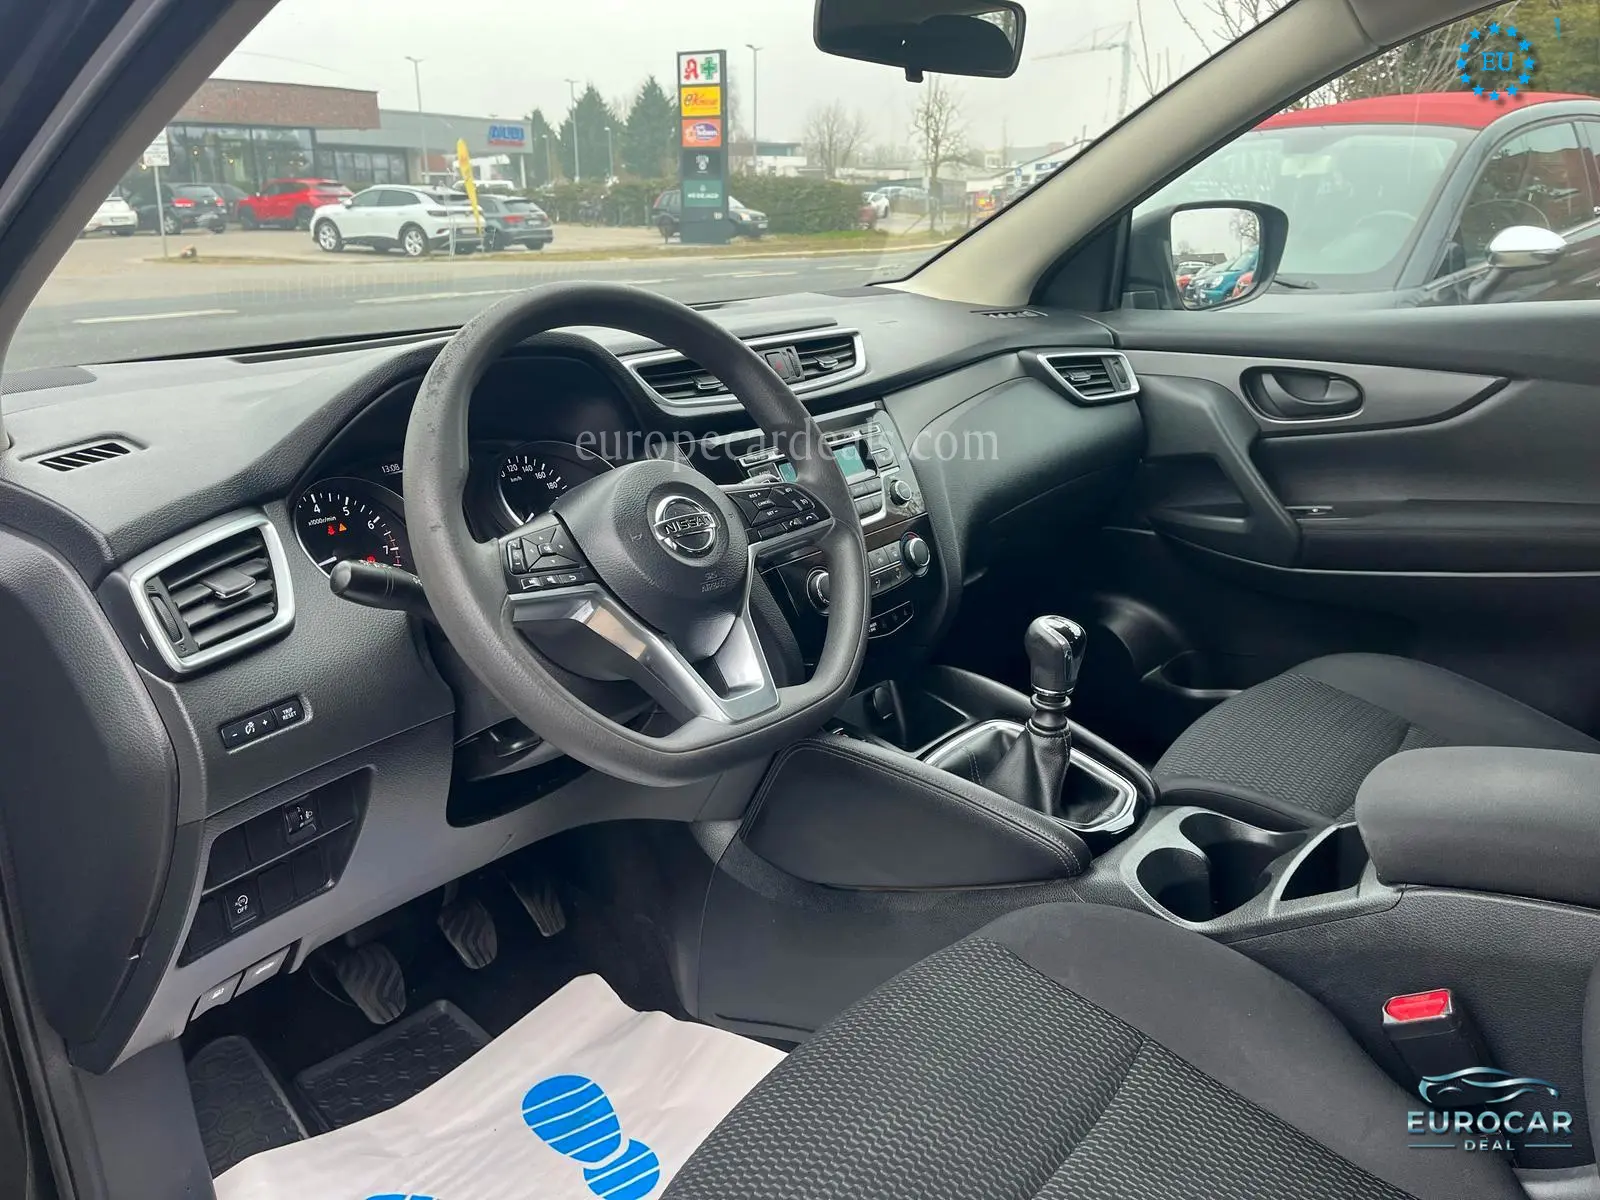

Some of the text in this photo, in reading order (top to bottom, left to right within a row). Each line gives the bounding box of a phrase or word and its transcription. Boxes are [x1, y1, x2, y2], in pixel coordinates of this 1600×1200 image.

[381, 463, 400, 473] 13:08
[507, 464, 518, 472] 120
[522, 464, 533, 473] 140
[535, 471, 546, 479] 160
[313, 504, 320, 513] 4
[342, 506, 350, 516] 5
[367, 520, 375, 530] 6
[664, 514, 711, 535] NISSAN
[382, 545, 389, 555] 7
[282, 711, 297, 720] RESET
[237, 904, 248, 914] OFF
